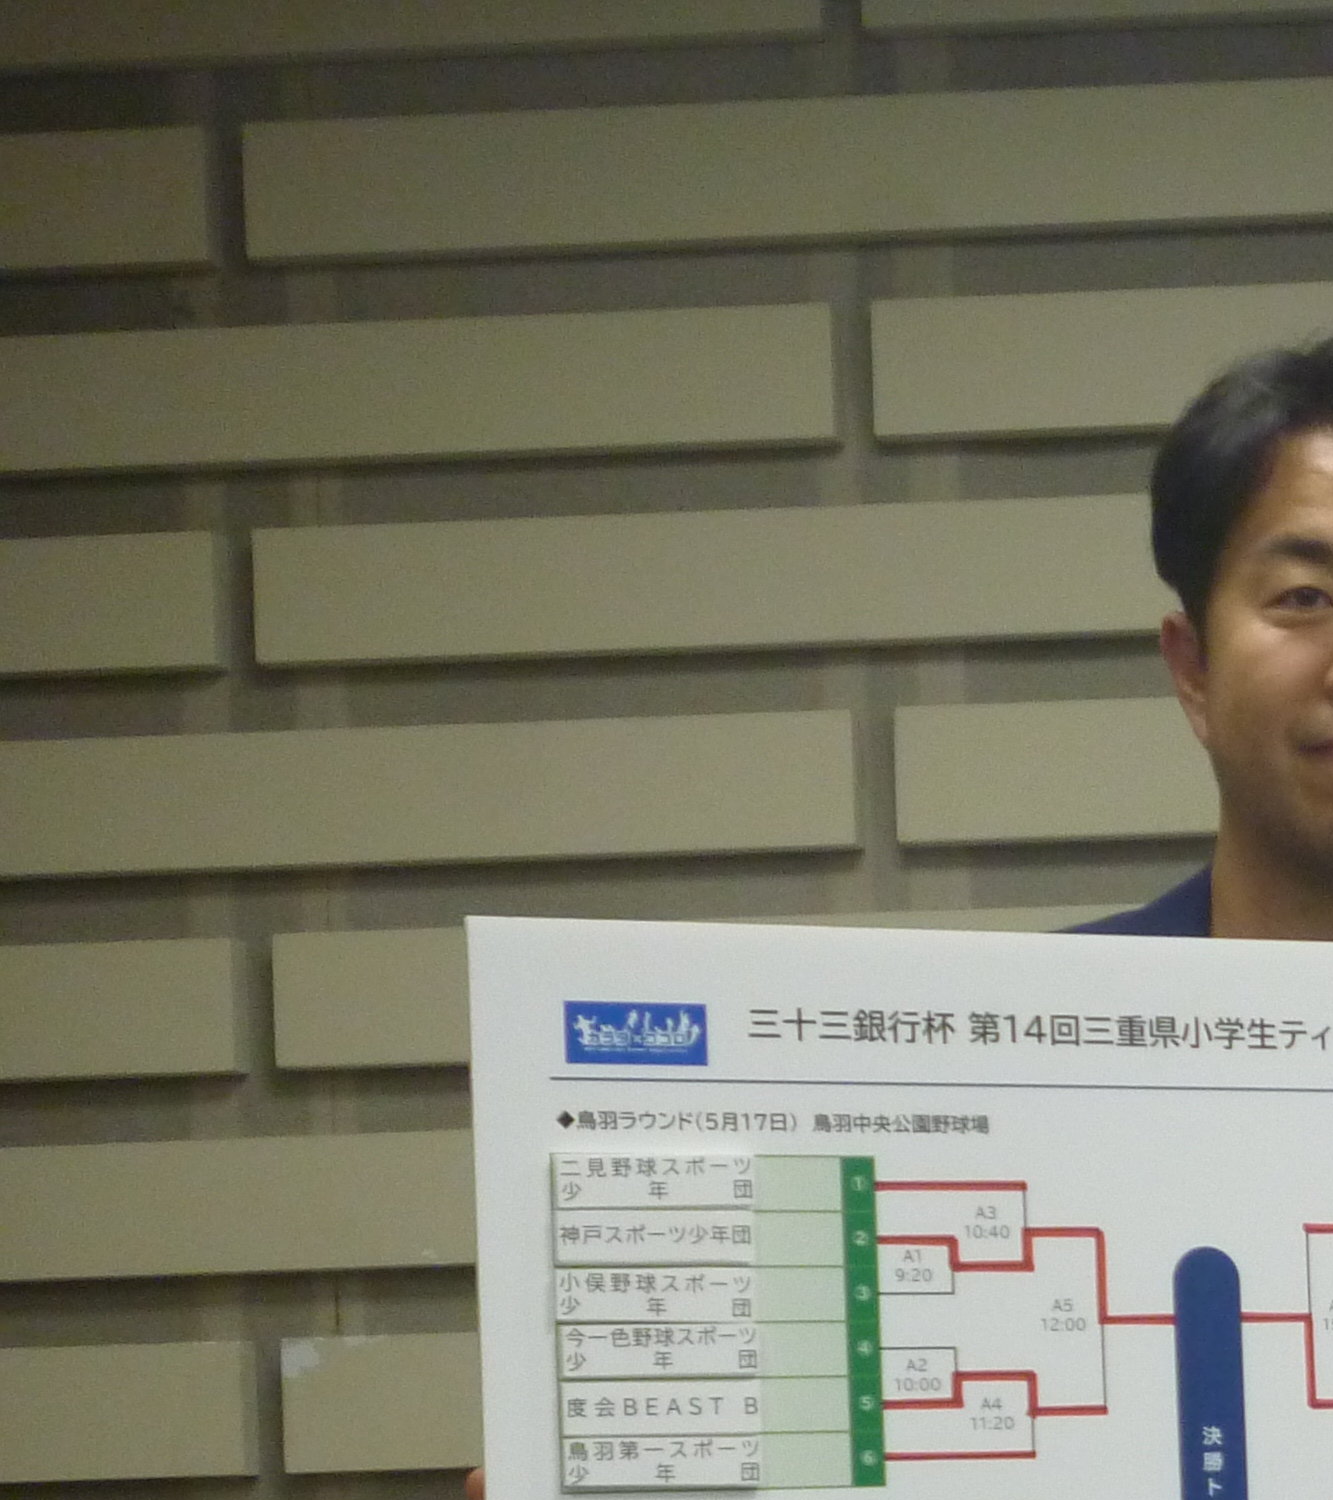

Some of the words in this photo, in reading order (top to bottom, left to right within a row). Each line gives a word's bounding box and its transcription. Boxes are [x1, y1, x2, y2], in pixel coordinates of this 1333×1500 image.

[748, 1008, 955, 1043] 三十三銀行杯
[813, 1113, 990, 1135] 鳥羽中央公園野球場
[560, 1157, 752, 1178] 二見野球スポーツ
[560, 1225, 752, 1245] 神戸スポーツ少年団
[964, 1224, 1011, 1240] 10:40
[895, 1268, 933, 1283] 9:20
[565, 1327, 757, 1348] 今一色野球スポーツ
